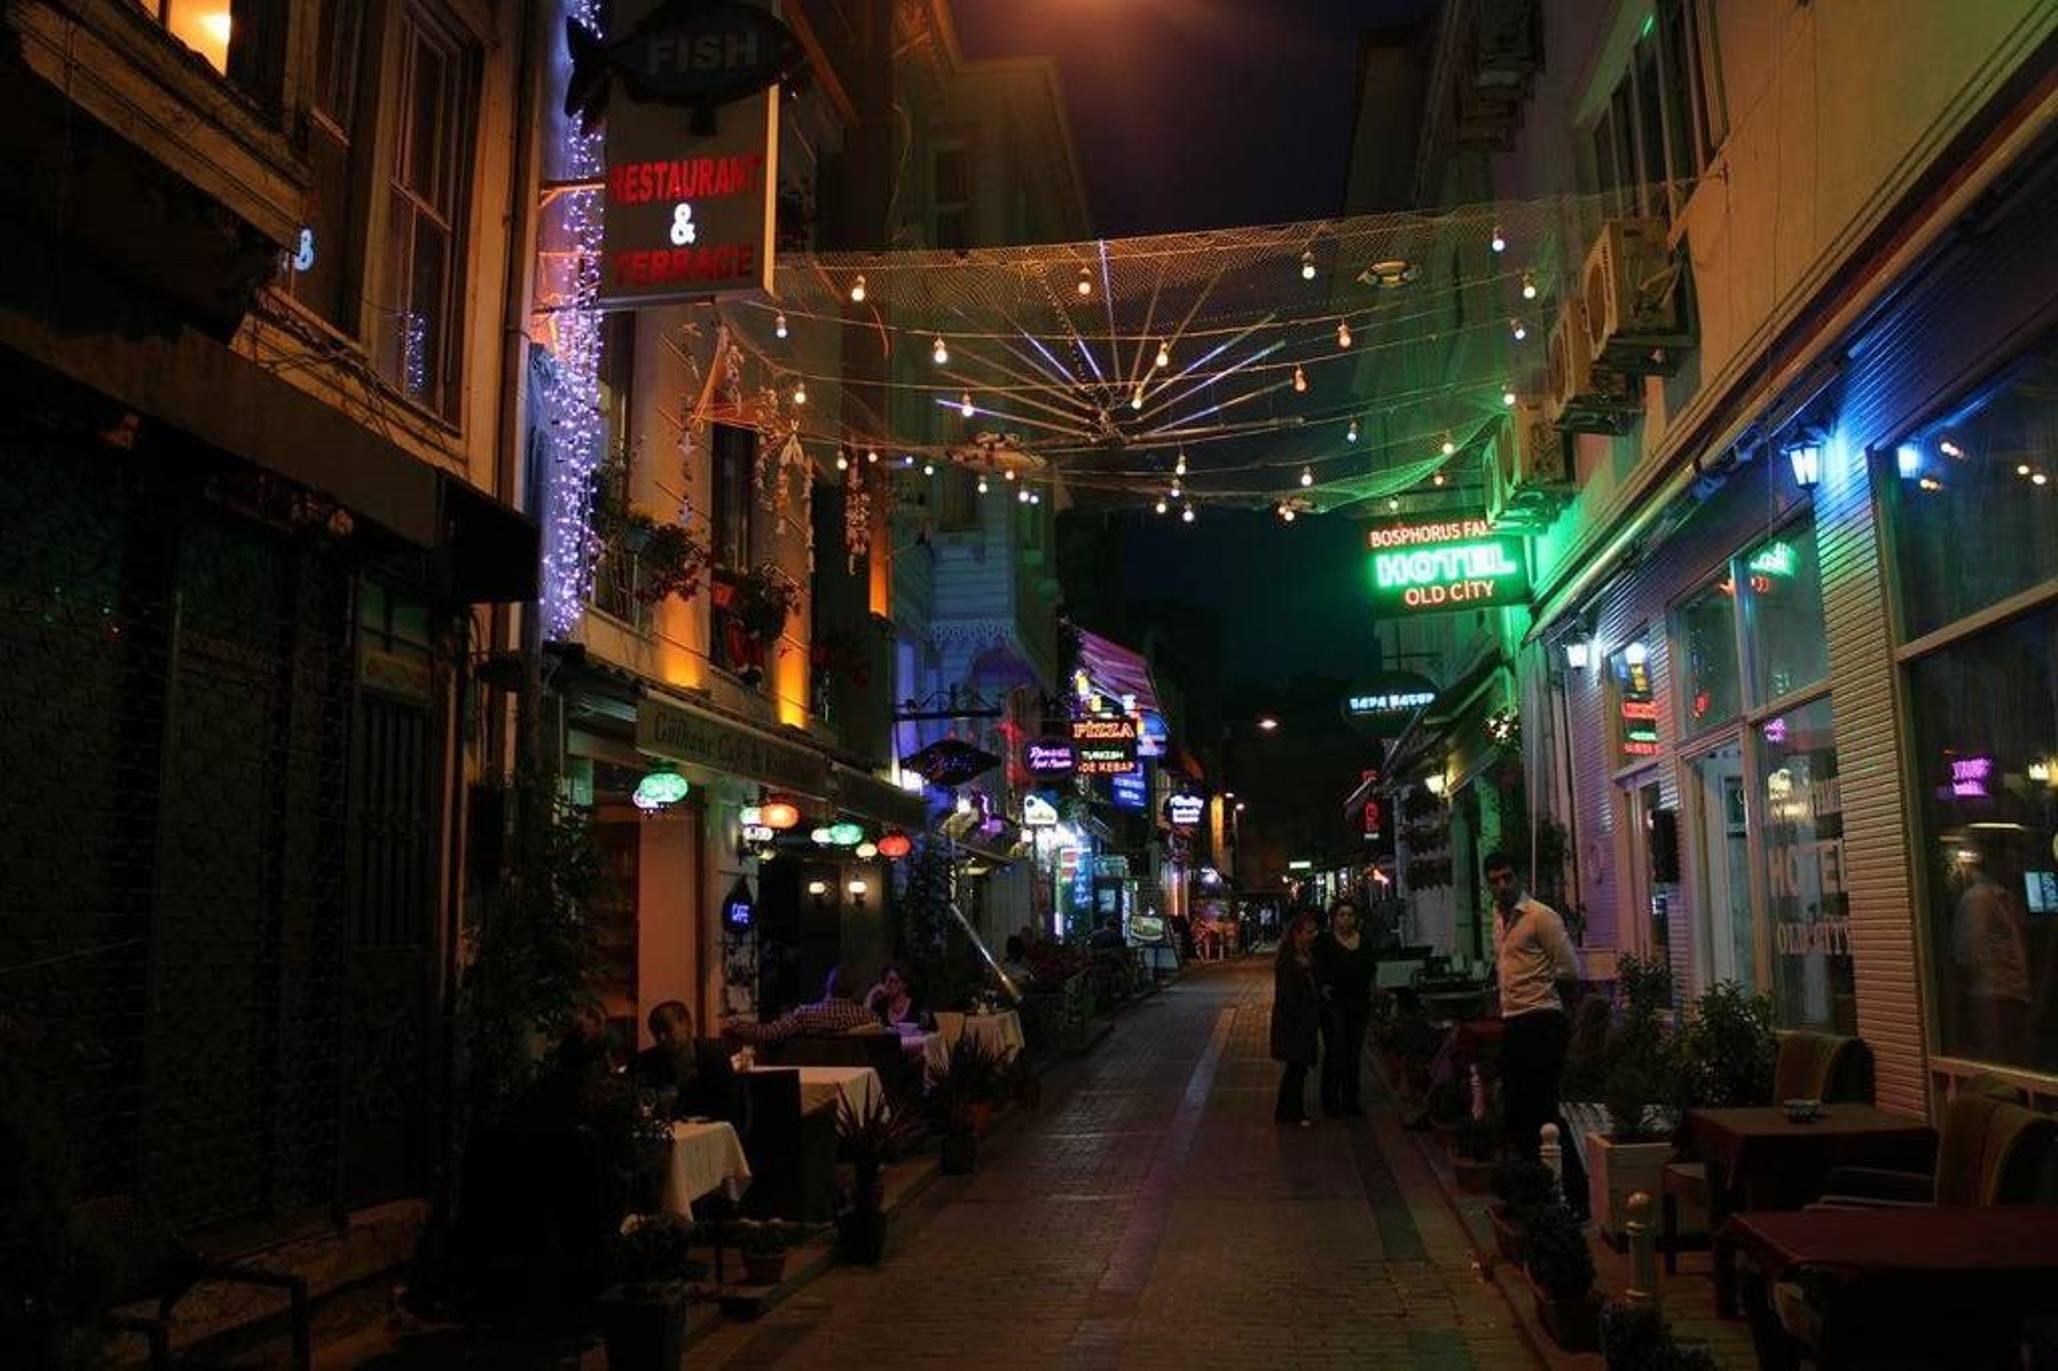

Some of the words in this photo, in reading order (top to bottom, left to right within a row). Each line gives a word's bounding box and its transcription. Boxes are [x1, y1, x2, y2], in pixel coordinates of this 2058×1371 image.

[645, 29, 758, 75] FISH
[611, 154, 762, 206] RESTAURANT
[670, 203, 697, 246] &
[1369, 523, 1461, 548] BOSPHORUS
[1374, 544, 1517, 588] HOTEL
[1405, 585, 1446, 606] OLD
